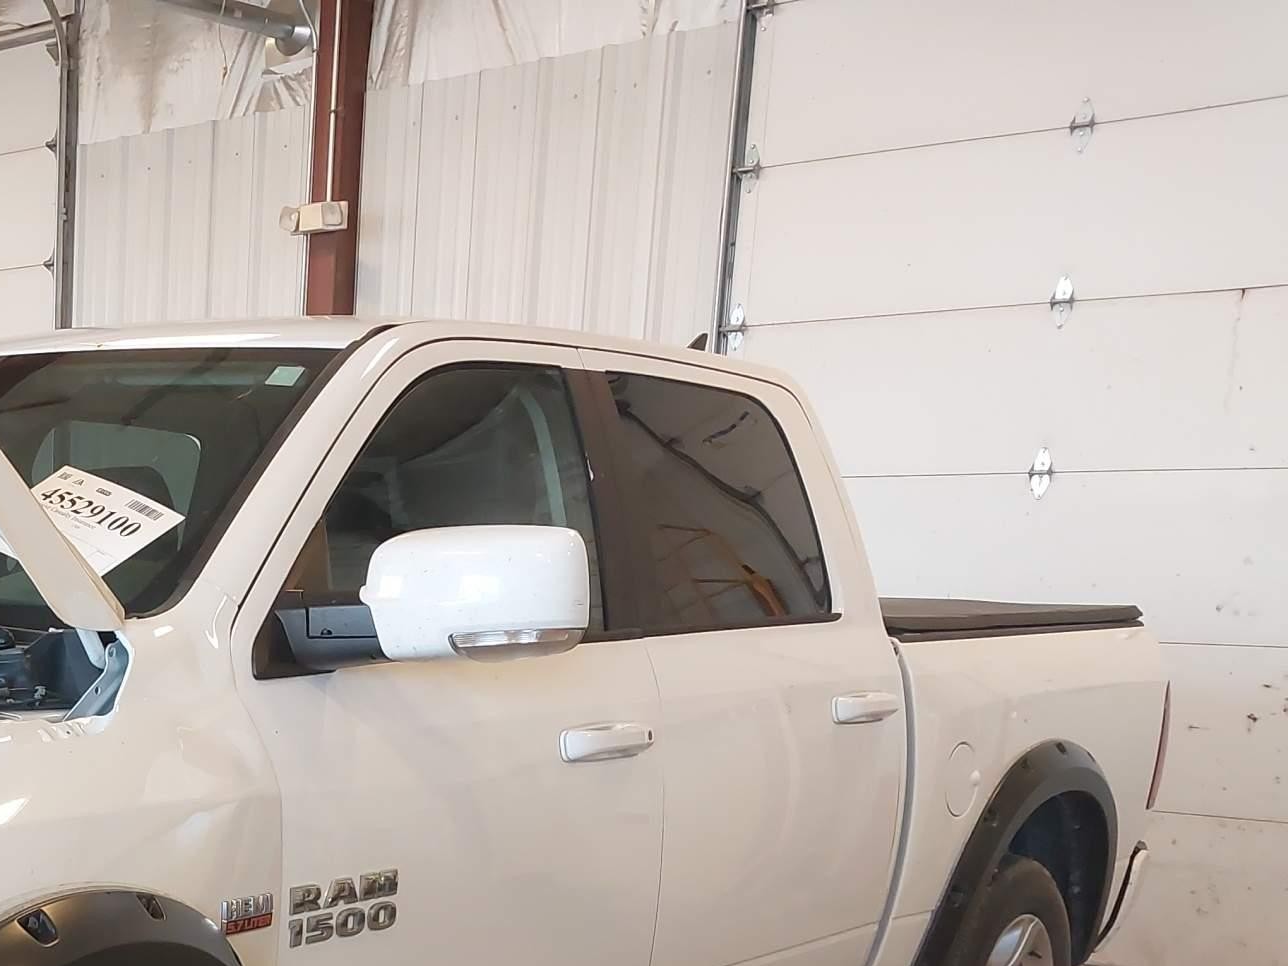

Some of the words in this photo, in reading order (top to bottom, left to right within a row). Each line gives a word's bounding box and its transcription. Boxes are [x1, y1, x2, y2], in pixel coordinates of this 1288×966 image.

[41, 488, 142, 537] 45529100
[221, 893, 273, 921] HEMI
[289, 868, 398, 916] RAM
[288, 900, 398, 949] 1500
